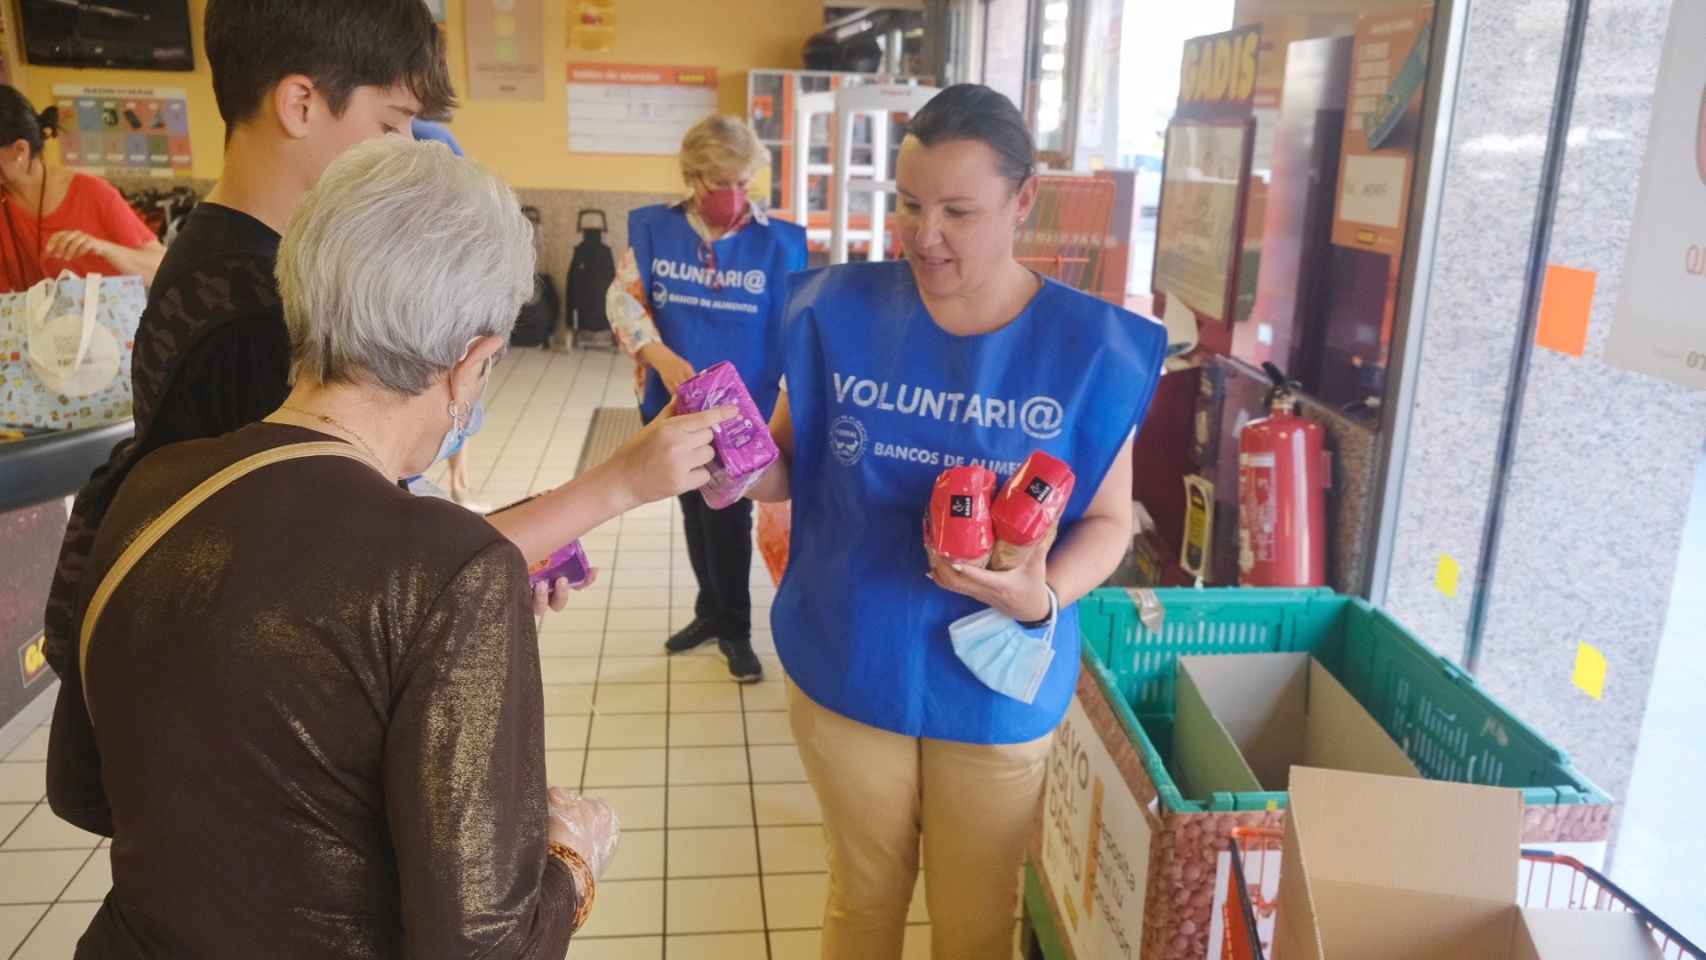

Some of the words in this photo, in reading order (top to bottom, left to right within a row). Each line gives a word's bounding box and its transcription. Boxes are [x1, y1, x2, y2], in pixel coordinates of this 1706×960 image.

[1184, 32, 1258, 99] GADIS
[833, 373, 1064, 439] VOLUNTARI@
[874, 442, 939, 465] BANCOS
[943, 453, 965, 467] DE
